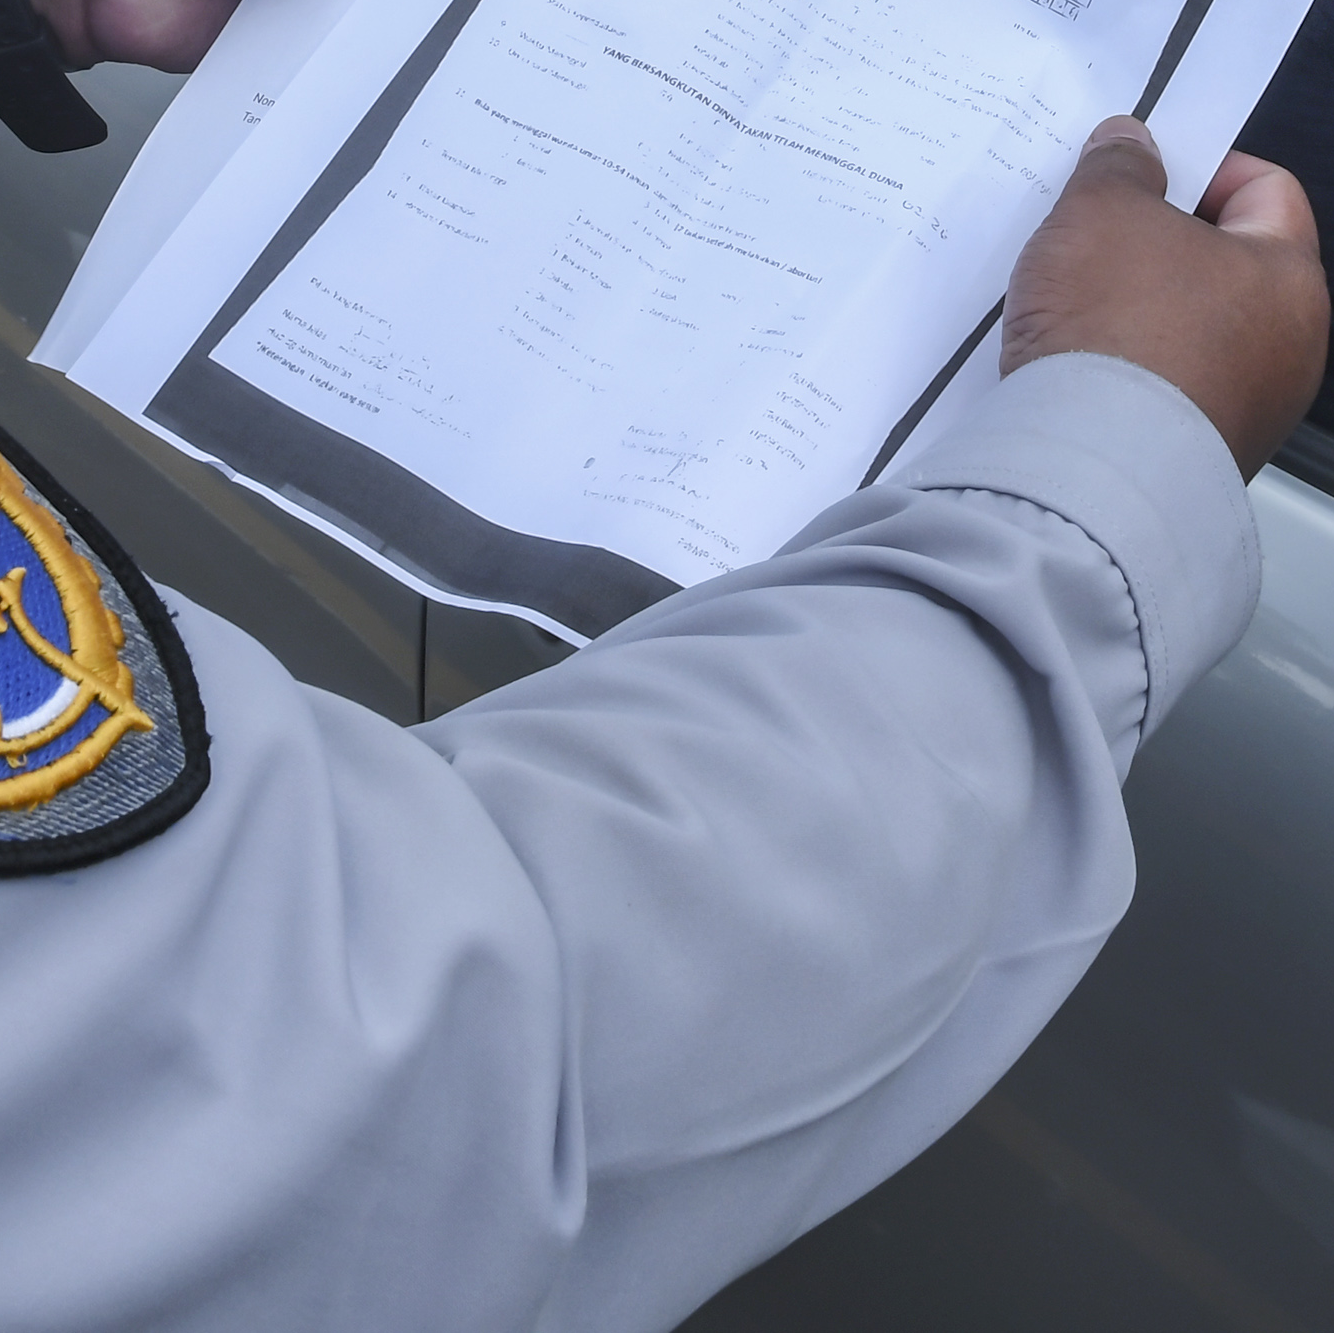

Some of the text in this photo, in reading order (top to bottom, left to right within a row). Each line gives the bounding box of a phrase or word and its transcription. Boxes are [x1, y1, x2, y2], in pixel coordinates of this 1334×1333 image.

[602, 45, 632, 64] YANG
[711, 102, 773, 141] DINYATAKAN
[804, 146, 867, 177] MENINGGAL
[868, 171, 904, 191] DUNIA
